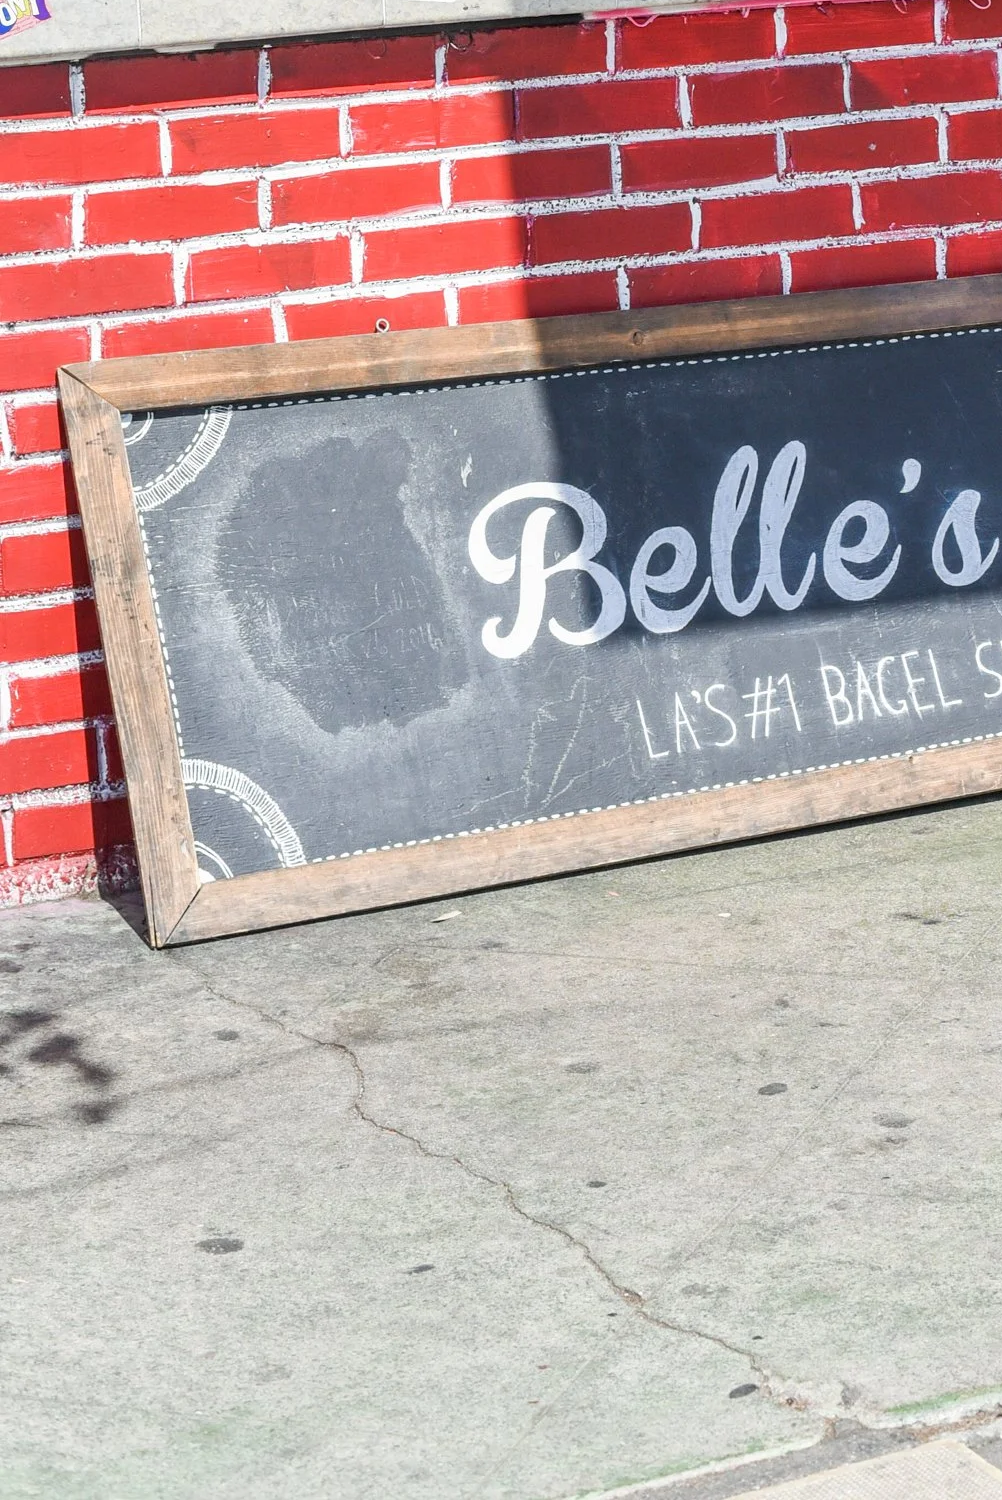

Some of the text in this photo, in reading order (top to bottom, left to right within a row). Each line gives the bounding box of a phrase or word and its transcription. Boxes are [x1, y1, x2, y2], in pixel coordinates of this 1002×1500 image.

[468, 440, 999, 660] Belle's
[635, 687, 749, 759] LA'S
[742, 670, 801, 741] #1
[822, 648, 963, 728] BAGEL
